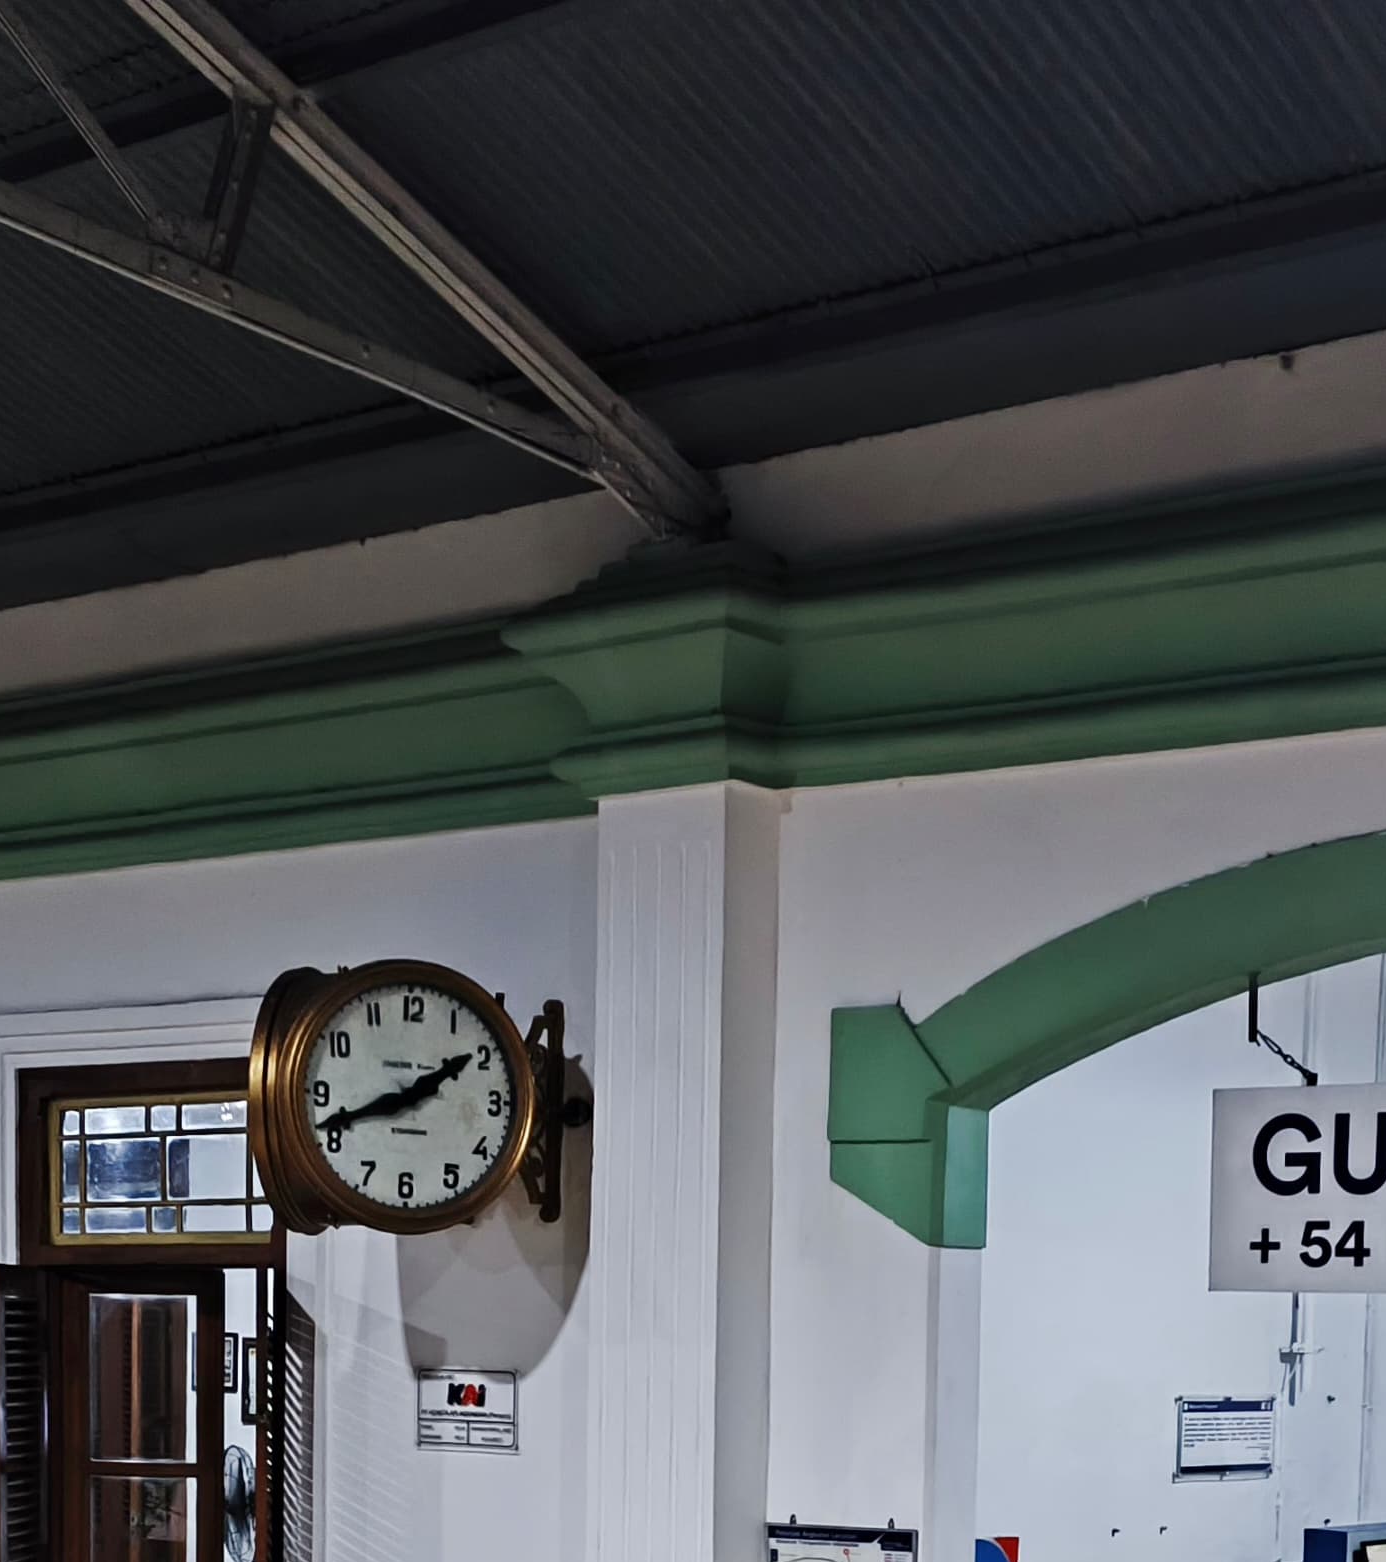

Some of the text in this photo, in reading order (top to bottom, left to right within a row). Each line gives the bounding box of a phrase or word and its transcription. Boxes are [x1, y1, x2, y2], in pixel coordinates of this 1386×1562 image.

[366, 1002, 382, 1027] 11
[402, 995, 425, 1023] 12
[449, 1008, 457, 1035] 1
[329, 1031, 351, 1058] 10
[477, 1045, 491, 1071] 2
[314, 1080, 330, 1107] 9
[487, 1090, 502, 1117] 3
[327, 1124, 342, 1153] 8
[472, 1135, 489, 1160] 4
[360, 1160, 377, 1187] 7
[397, 1172, 414, 1199] 6
[443, 1162, 460, 1189] 5
[1298, 1219, 1371, 1268] 54
